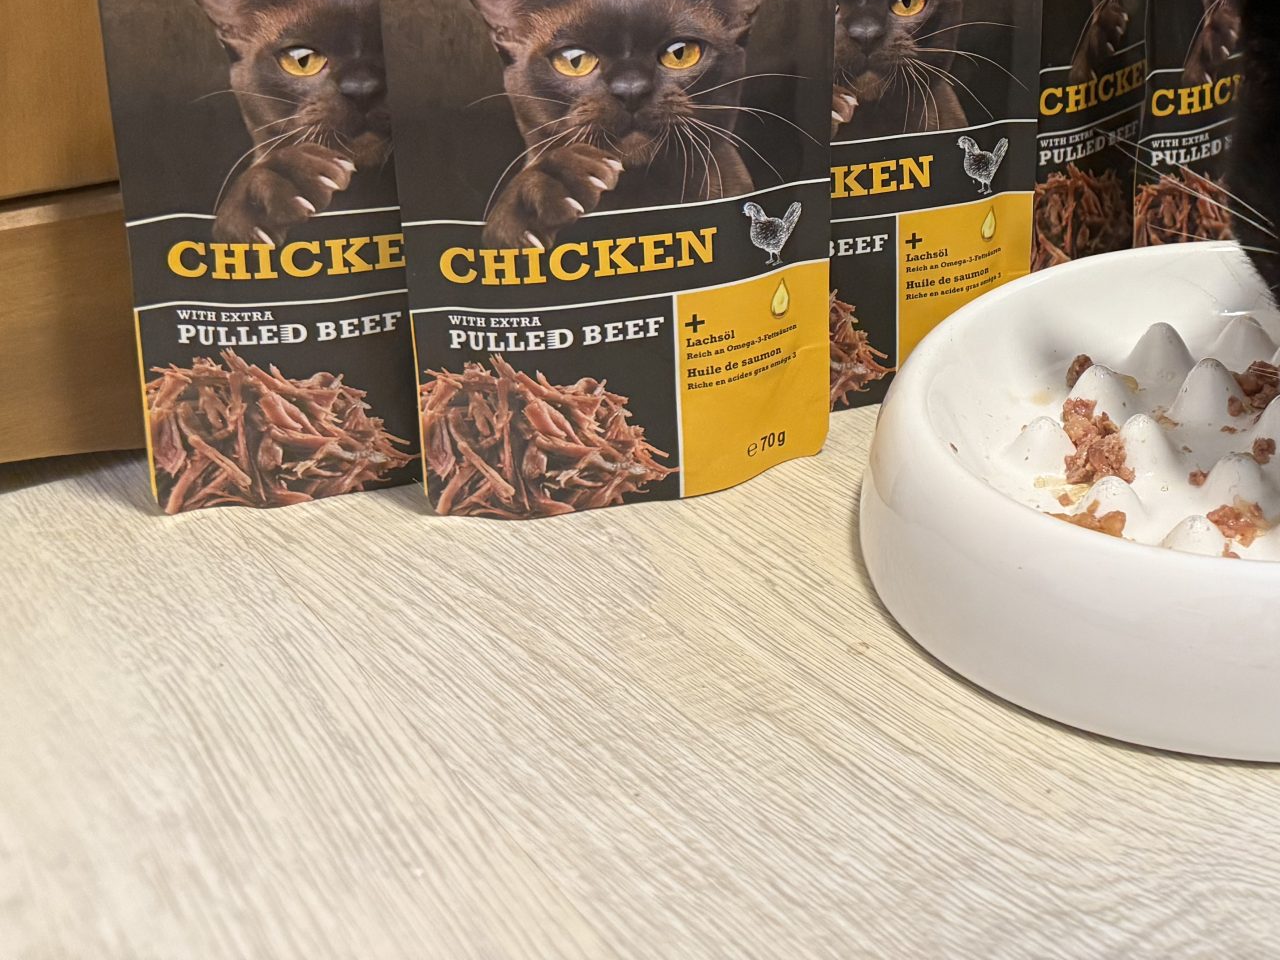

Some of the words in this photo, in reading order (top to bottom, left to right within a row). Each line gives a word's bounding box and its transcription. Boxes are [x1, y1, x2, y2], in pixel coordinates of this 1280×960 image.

[1040, 135, 1067, 148] WITH
[1151, 138, 1179, 149] WITH
[1181, 132, 1209, 146] EXTRA
[1039, 135, 1105, 166] PULLED
[1150, 139, 1222, 167] PULLED
[439, 227, 717, 286] CHICKEN
[905, 248, 948, 262] Lachsöl
[906, 264, 928, 273] Reich
[905, 278, 936, 289] Huile
[938, 276, 951, 285] de
[953, 267, 990, 282] saumon
[906, 291, 928, 300] Riche
[940, 286, 964, 296] acides
[965, 282, 980, 292] gras
[177, 309, 217, 322] WITH
[221, 311, 274, 322] EXTRA
[448, 315, 486, 327] WITH
[490, 316, 542, 328] EXTRA
[177, 324, 308, 346] PULLED
[317, 311, 402, 342] BEEF
[449, 328, 574, 352] PULLED
[582, 317, 665, 346] BEEF
[686, 329, 735, 347] Lachsöl
[686, 351, 712, 360] Reich
[687, 365, 722, 378] Huile
[725, 361, 739, 371] de
[742, 347, 782, 367] saumon
[687, 381, 714, 390] Riche
[728, 371, 753, 383] acides
[754, 365, 769, 376] gras
[792, 351, 797, 359] 3
